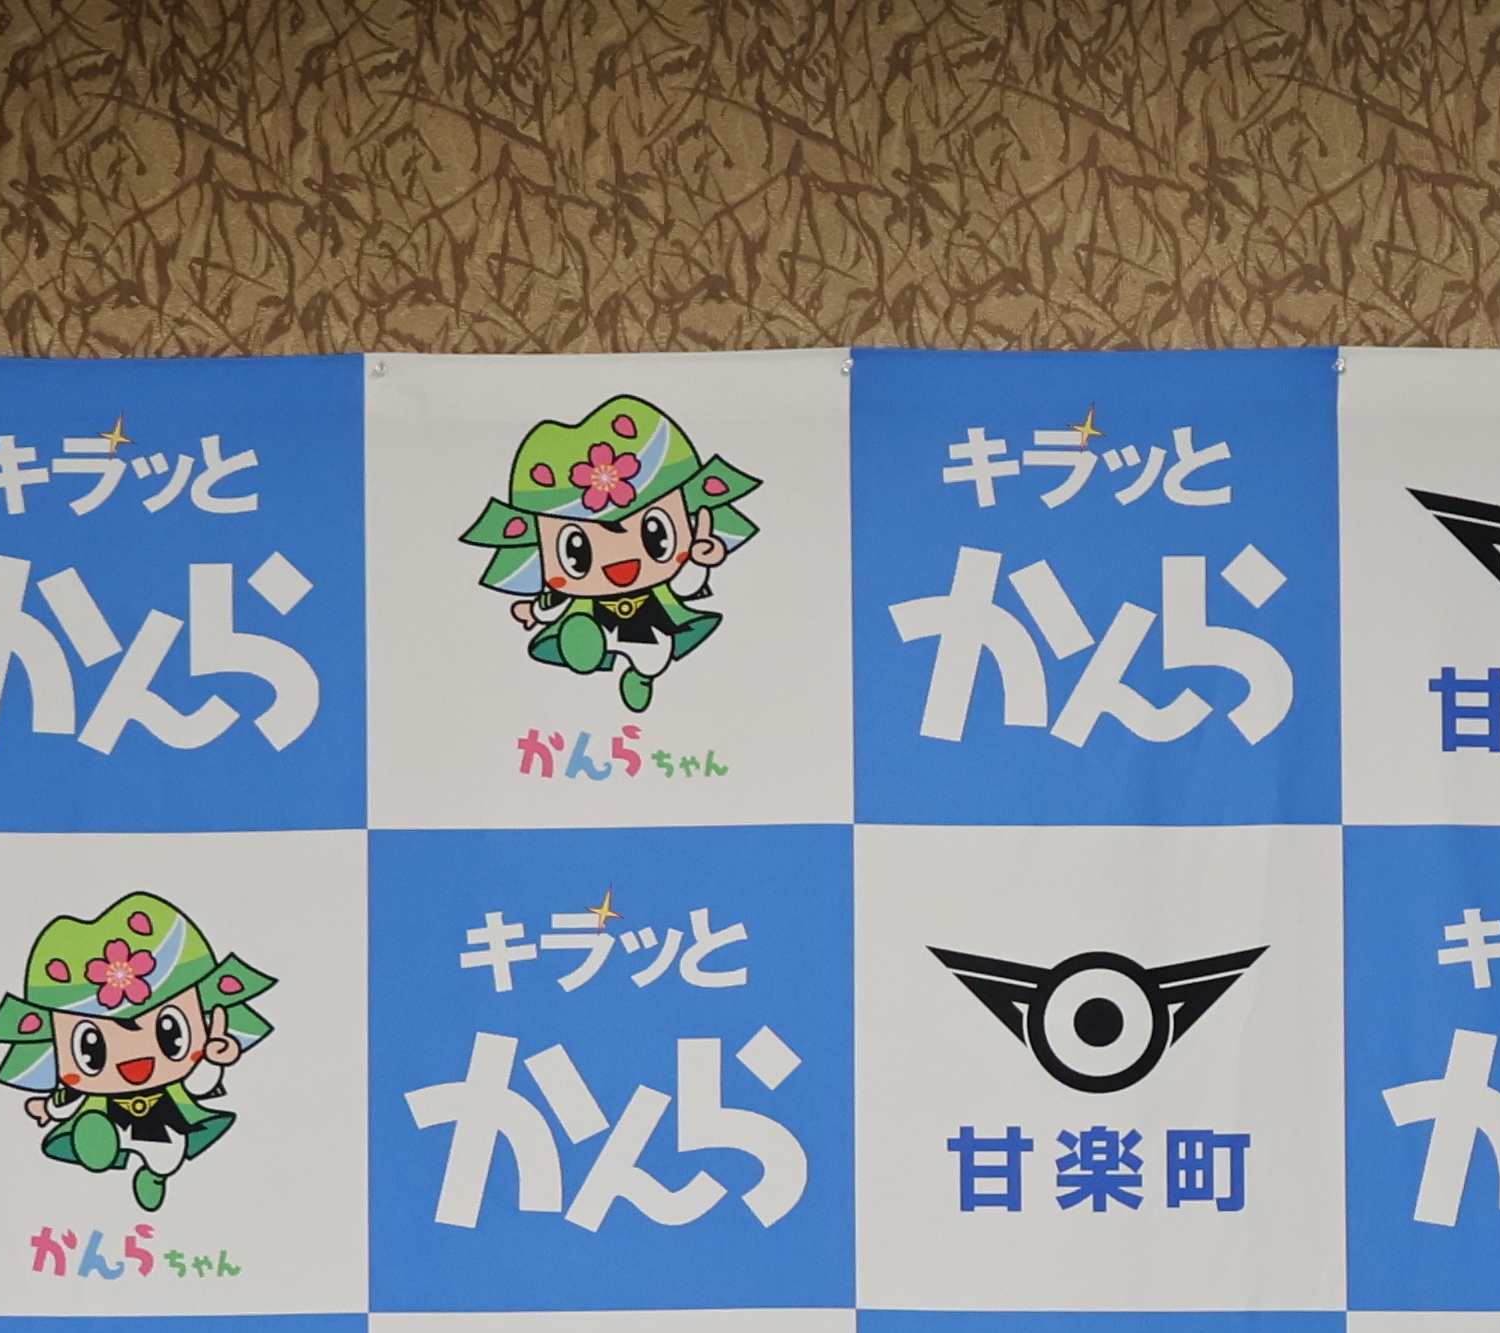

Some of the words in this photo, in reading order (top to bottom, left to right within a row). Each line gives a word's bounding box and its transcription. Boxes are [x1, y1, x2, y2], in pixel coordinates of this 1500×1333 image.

[943, 427, 1231, 507] キラッと
[889, 545, 1293, 747] かんら
[519, 726, 727, 780] かんらちゃん
[461, 909, 747, 991] キラッと
[405, 1026, 807, 1232] かんら
[948, 1126, 1250, 1211] 甘楽町
[32, 1225, 239, 1279] かんらちゃん
